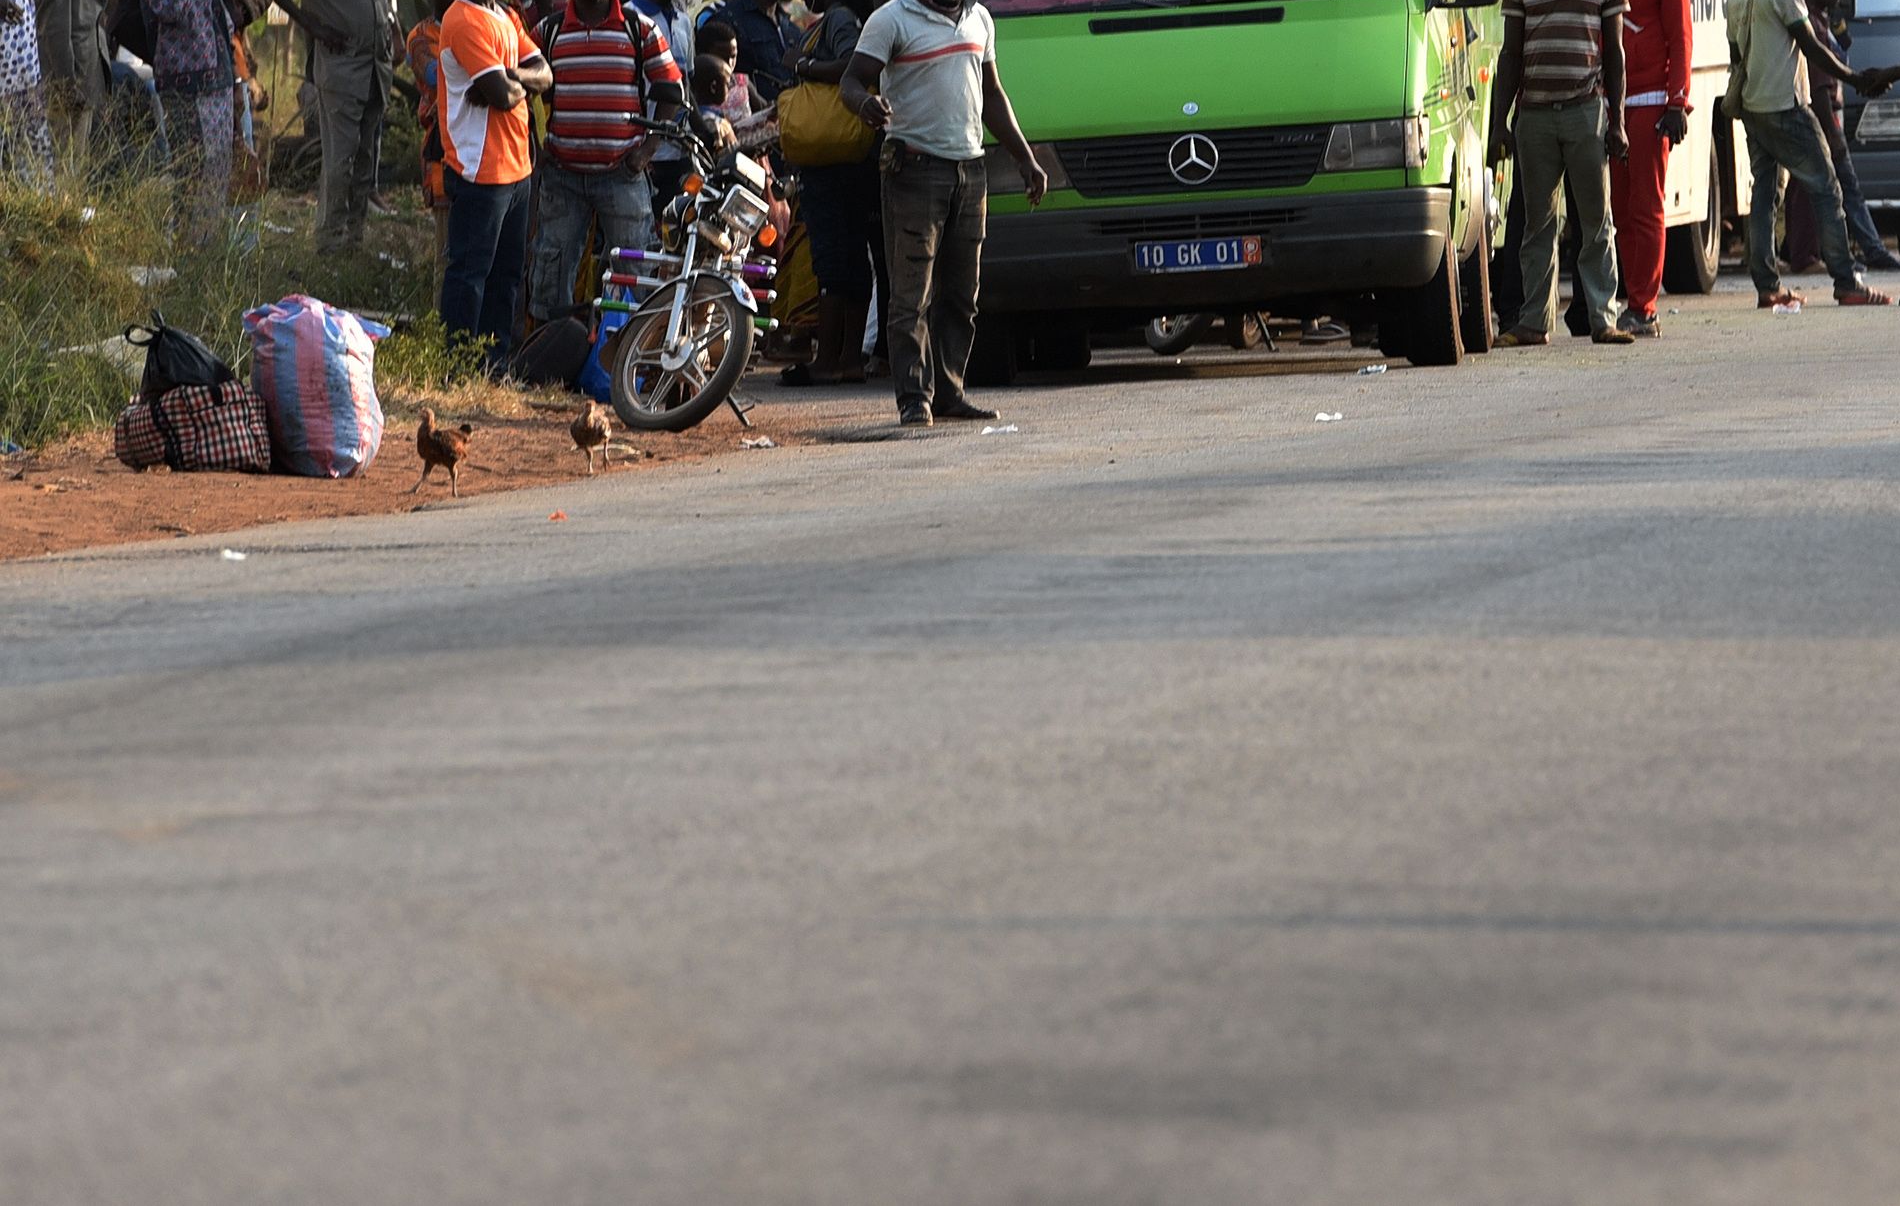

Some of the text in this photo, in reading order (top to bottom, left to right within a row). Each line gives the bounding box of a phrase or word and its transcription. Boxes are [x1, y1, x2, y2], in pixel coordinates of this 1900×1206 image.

[1142, 240, 1240, 267] 10 GK 01
